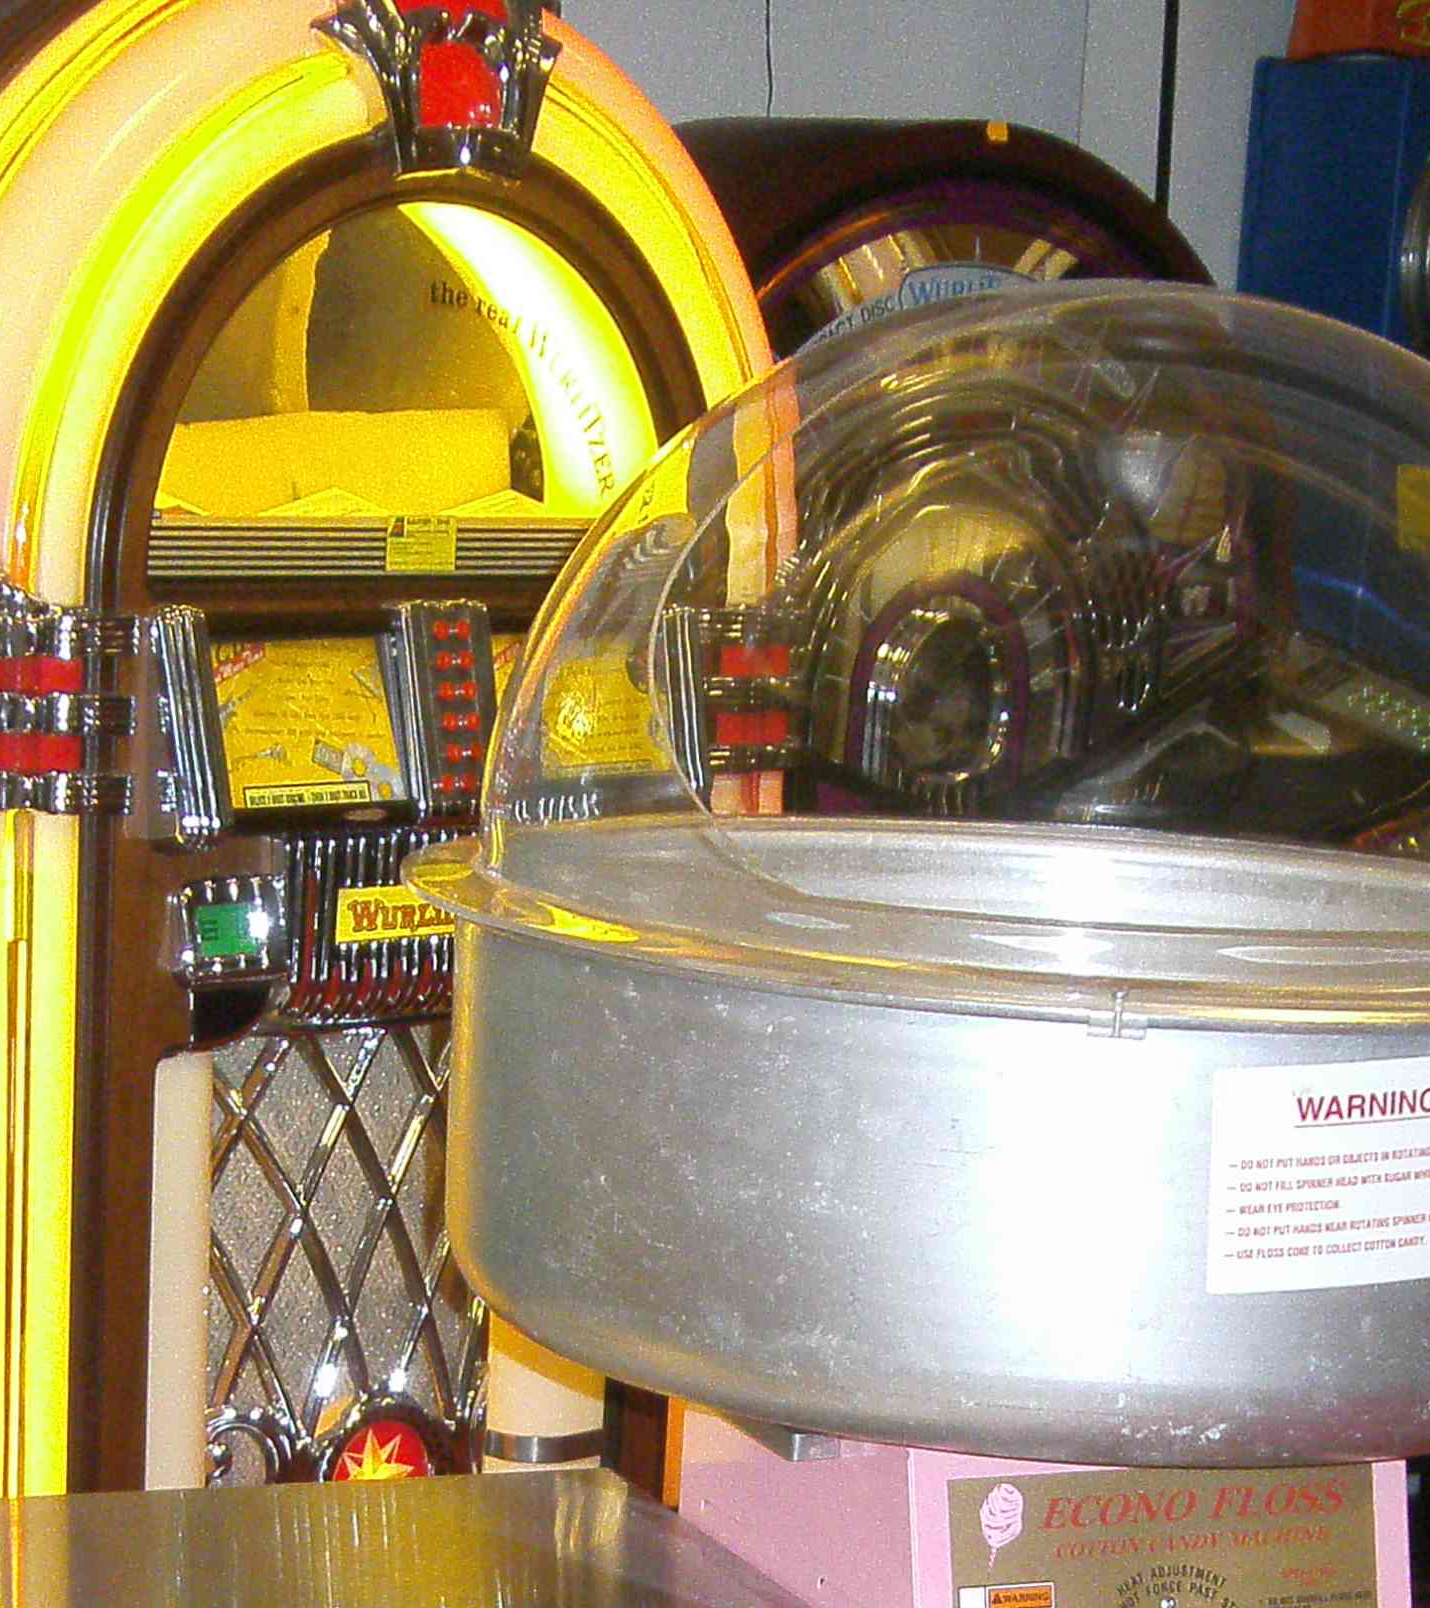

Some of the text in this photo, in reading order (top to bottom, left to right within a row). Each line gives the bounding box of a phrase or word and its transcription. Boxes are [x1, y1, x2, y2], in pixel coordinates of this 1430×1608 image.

[430, 280, 468, 305] the
[1240, 1159, 1253, 1170] DO
[1256, 1158, 1274, 1169] NOT
[1276, 1156, 1293, 1168] PUT
[1296, 1154, 1326, 1167] HANDS
[1328, 1154, 1340, 1165] OR
[1343, 1151, 1379, 1164] OBJECTS
[1392, 1146, 1430, 1160] ROTATING
[1239, 1181, 1252, 1192] DO
[1255, 1180, 1273, 1191] NOT
[1275, 1180, 1293, 1190] FILL
[1296, 1177, 1333, 1190] SPINNER
[1336, 1175, 1358, 1187] HEAD
[1360, 1173, 1382, 1185] WITH
[1385, 1171, 1411, 1182] SUGAR
[1239, 1203, 1264, 1214] WEAR
[1267, 1202, 1284, 1214] EYE
[1237, 1226, 1250, 1237] DO
[1253, 1225, 1271, 1237] NOT
[1273, 1224, 1290, 1236] PUT
[1293, 1222, 1323, 1234] HANDS
[1325, 1220, 1348, 1232] NEAR
[1350, 1216, 1390, 1230] ROTATING
[1392, 1213, 1426, 1226] SPINNER
[1236, 1248, 1253, 1259] USE
[1256, 1247, 1284, 1259] FLOSS
[1287, 1245, 1310, 1257] CONE
[1313, 1244, 1324, 1256] TO
[1326, 1241, 1362, 1254] COLLECT
[1364, 1238, 1396, 1251] COTTON
[1038, 1477, 1350, 1531] ECONO FLOSS
[1055, 1535, 1140, 1559] COTTON
[1147, 1532, 1221, 1553] CANDY
[1116, 1564, 1227, 1597] HEAT ADJUSTMENT
[1146, 1579, 1182, 1597] FORCE
[1189, 1581, 1218, 1600] PAST
